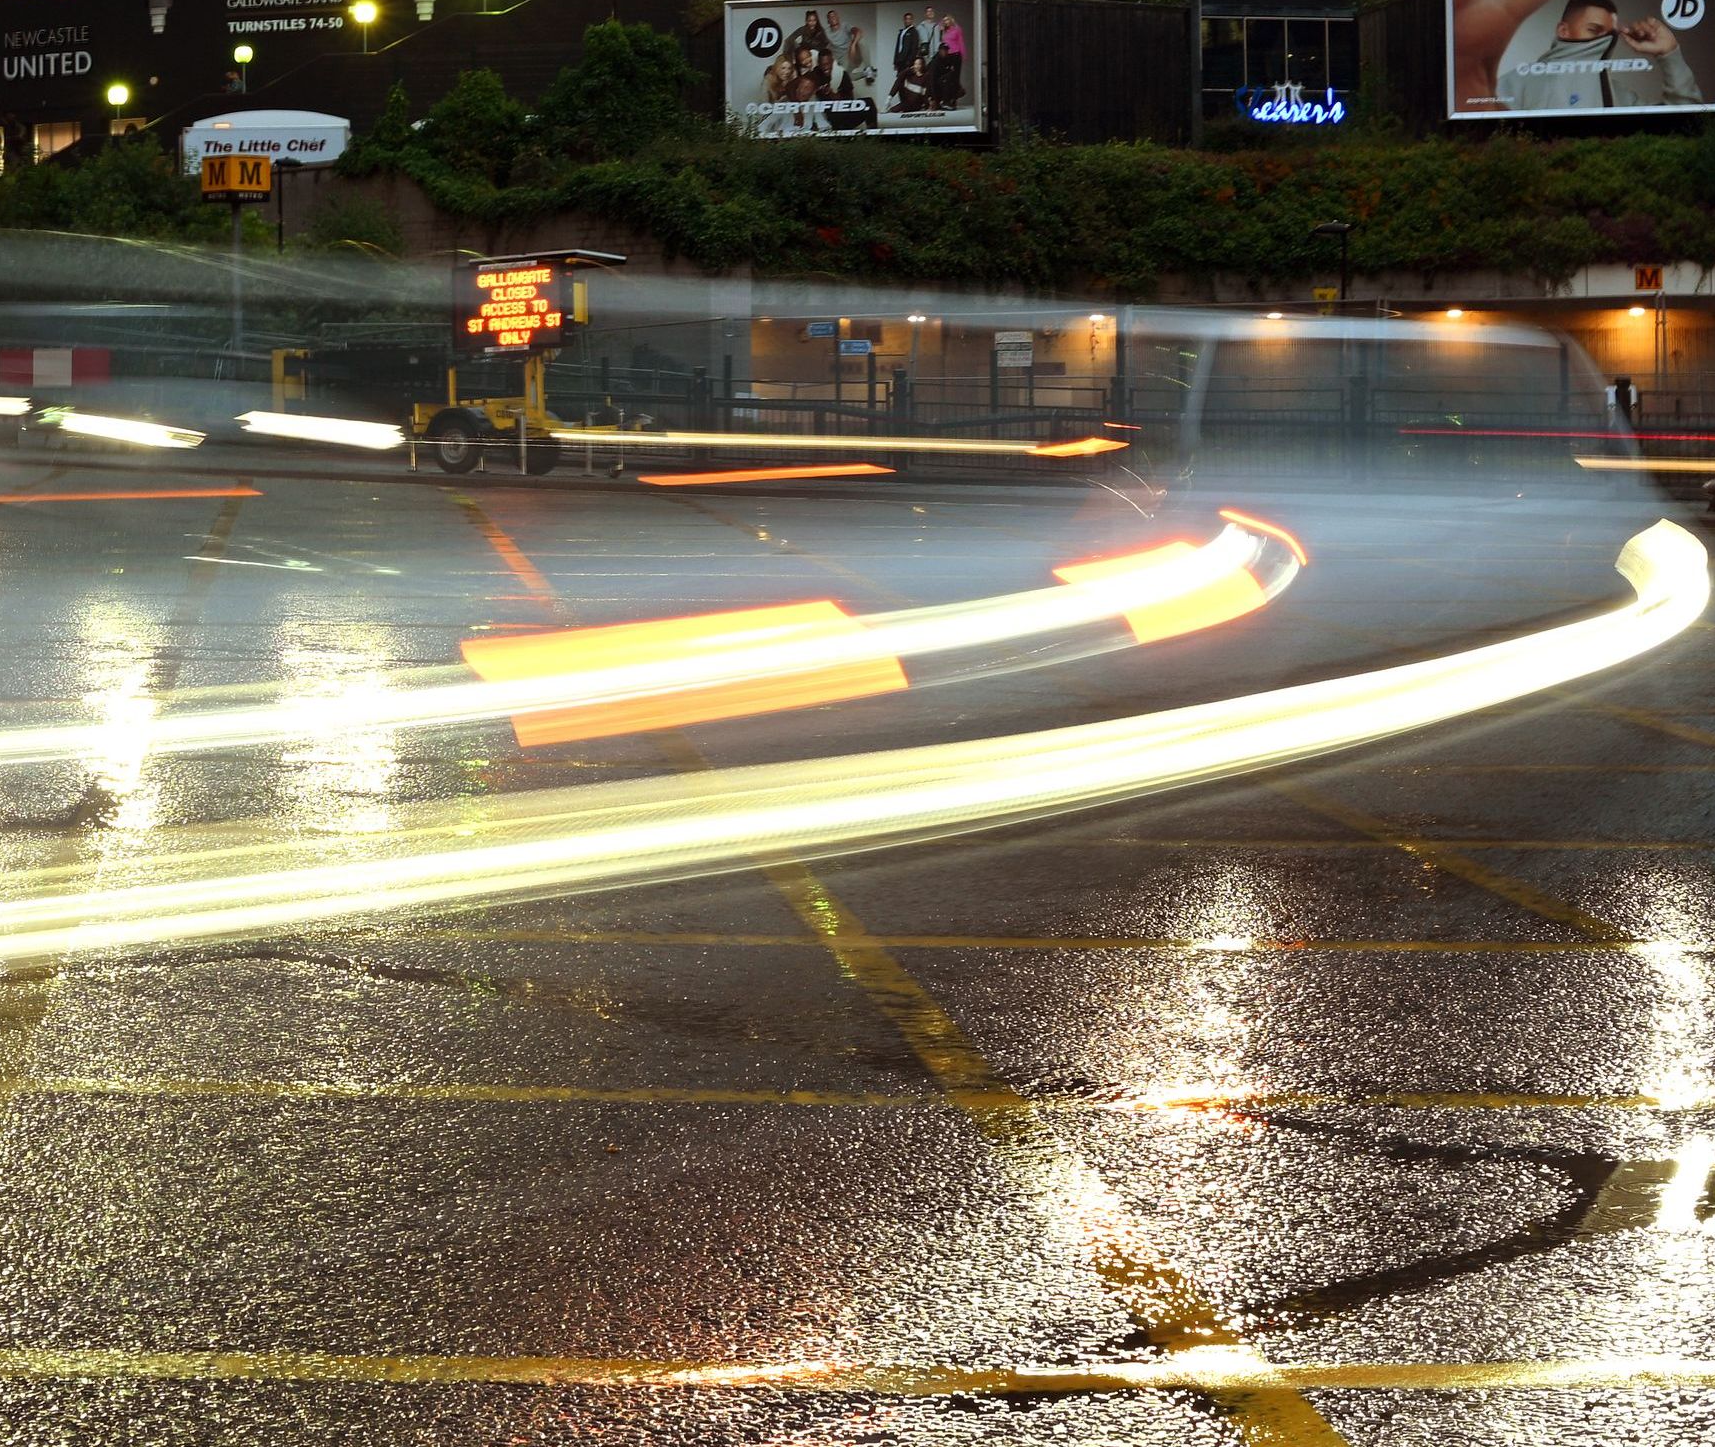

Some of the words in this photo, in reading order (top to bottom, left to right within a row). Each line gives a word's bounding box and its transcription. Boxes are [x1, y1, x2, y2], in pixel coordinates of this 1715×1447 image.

[228, 18, 305, 33] TURNSTILES
[309, 17, 344, 29] 74-50
[4, 26, 89, 49] NEWCASTLE
[749, 27, 779, 49] JD
[3, 51, 92, 80] UNITED
[204, 140, 232, 153] The
[238, 139, 281, 153] Little
[287, 138, 326, 152] Chef
[208, 161, 226, 186] M
[239, 160, 262, 185] M
[476, 269, 551, 288] GALLOWGATE
[1638, 268, 1660, 287] M
[491, 286, 536, 301] CLOSED
[481, 302, 525, 317] ACCESS
[531, 299, 548, 313] TO
[467, 319, 484, 333] ST
[488, 315, 540, 331] ANDREWS
[545, 313, 561, 326] ST
[499, 330, 530, 345] ONLY
